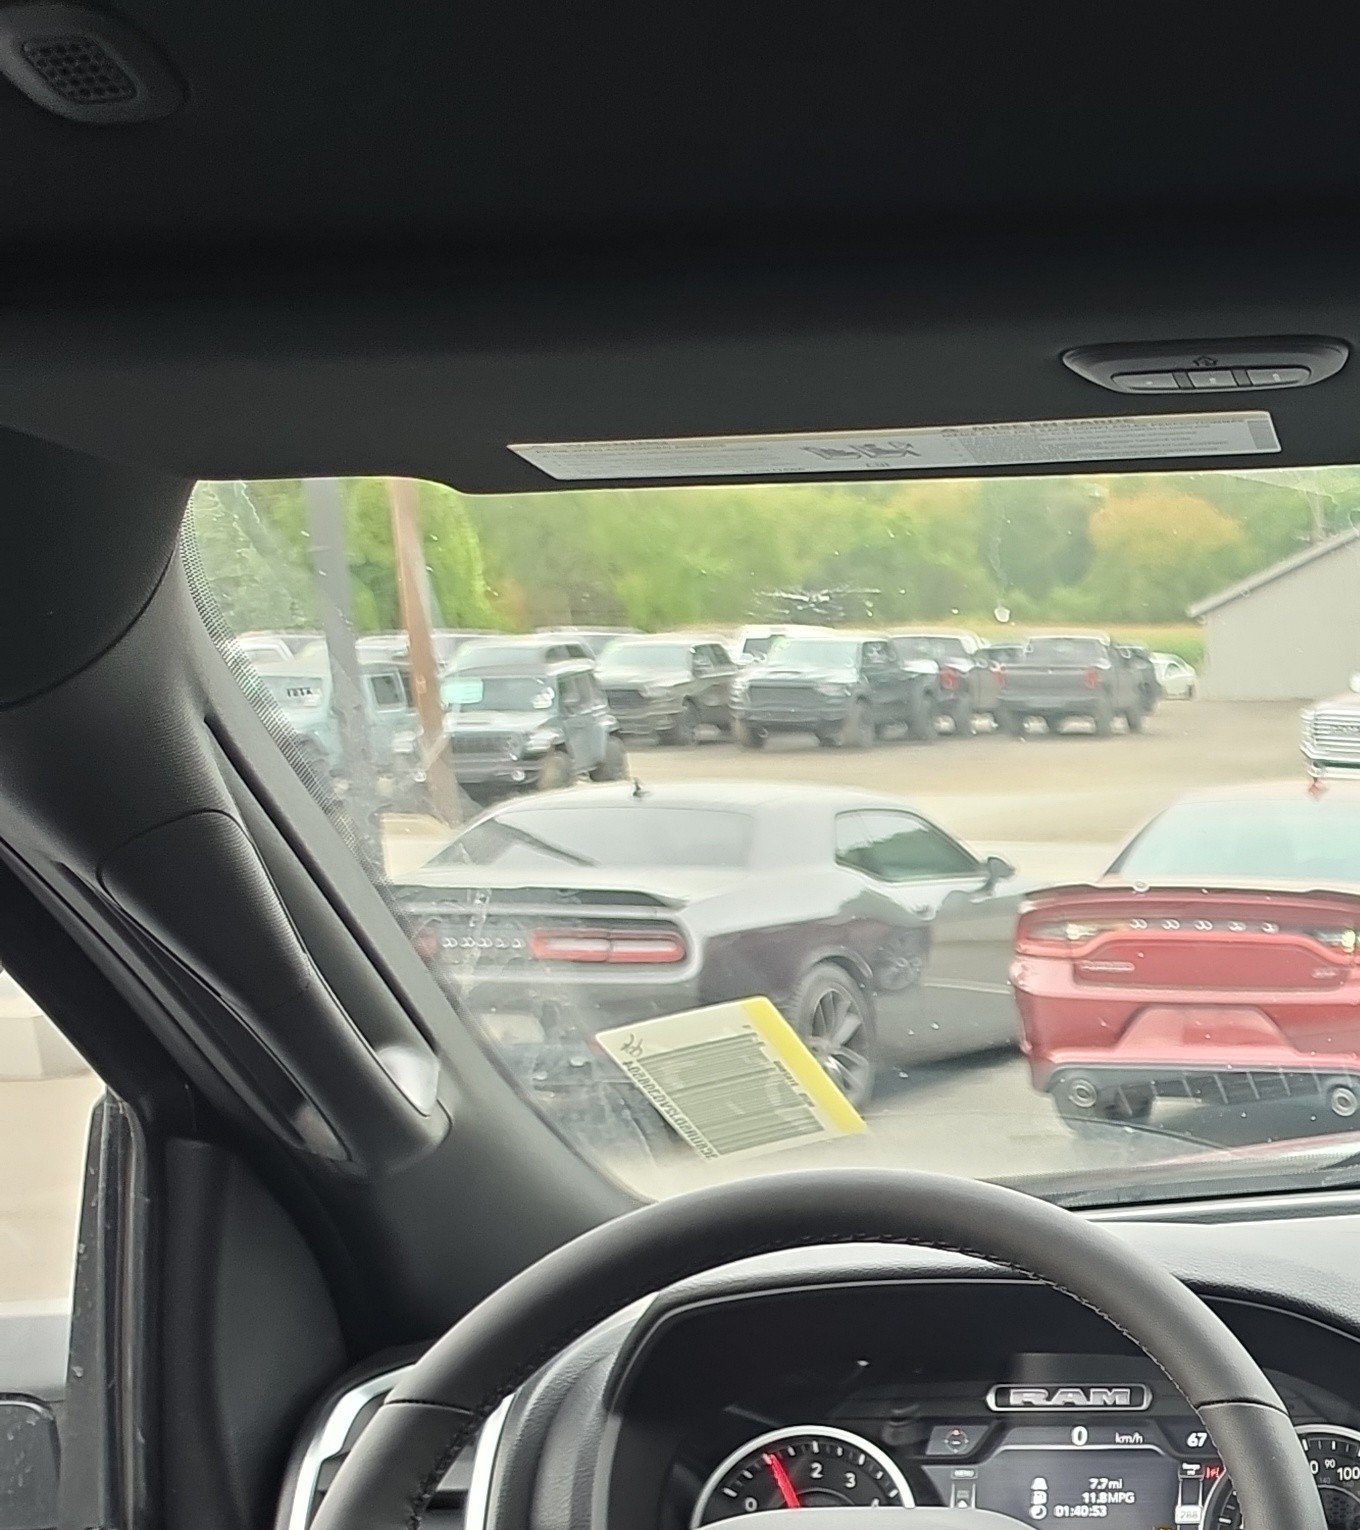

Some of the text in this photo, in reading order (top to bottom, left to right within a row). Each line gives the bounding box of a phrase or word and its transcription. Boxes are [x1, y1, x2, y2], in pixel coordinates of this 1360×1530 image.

[1009, 1387, 1131, 1406] RAM
[1072, 1426, 1143, 1446] 0 km/h
[810, 1462, 823, 1479] 2
[1324, 1458, 1336, 1469] 90
[845, 1472, 857, 1488] 3
[1336, 1466, 1360, 1481] 100
[745, 1497, 758, 1512] 0
